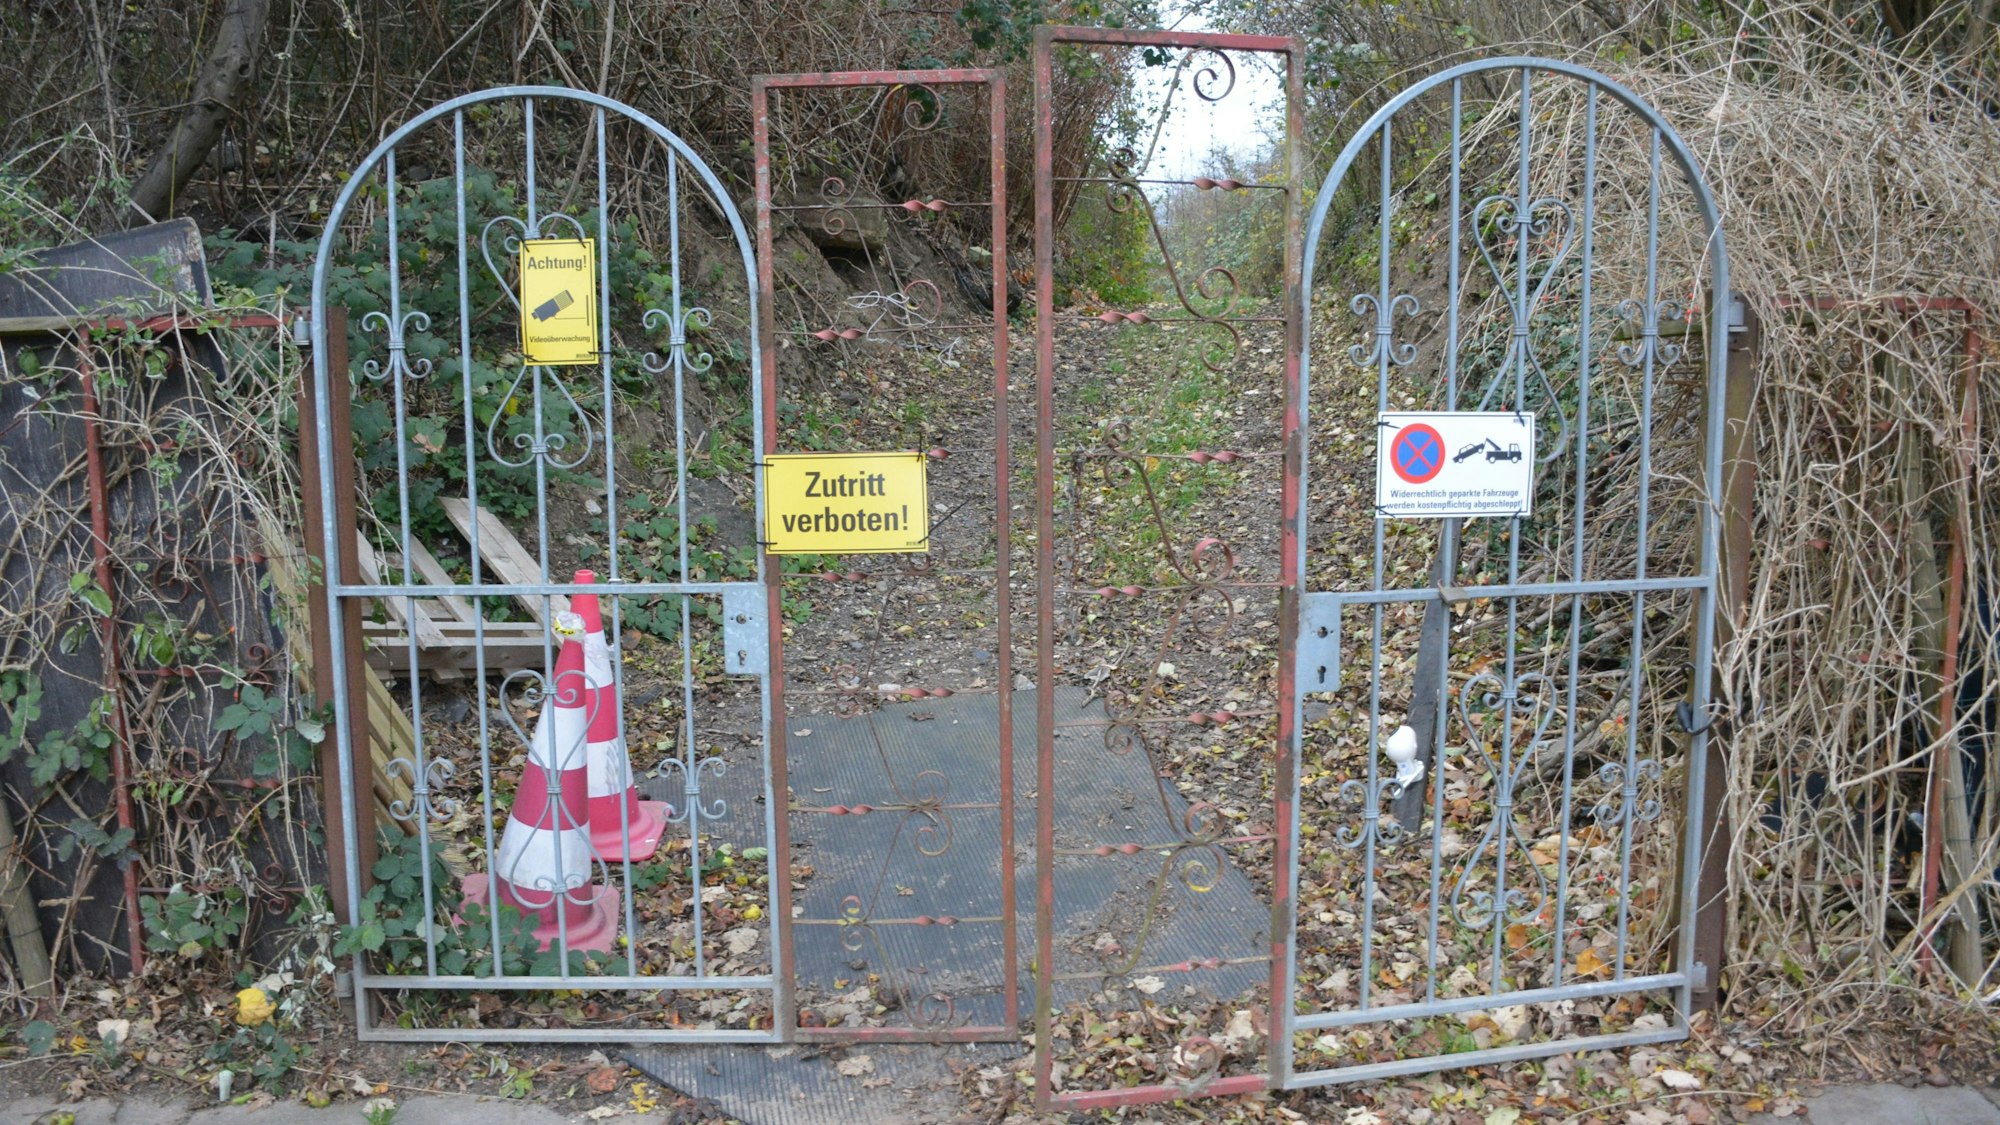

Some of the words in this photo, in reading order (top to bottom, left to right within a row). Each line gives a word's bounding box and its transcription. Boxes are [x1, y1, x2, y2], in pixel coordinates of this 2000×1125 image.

[527, 255, 587, 271] Achtung!
[529, 335, 591, 343] Videoüberwachung
[805, 471, 886, 498] Zutritt
[1390, 489, 1447, 498] Widerrechtlich
[1448, 490, 1481, 499] geparkte
[1482, 488, 1519, 498] Fahrzeuge
[1386, 501, 1416, 509] werden
[1417, 500, 1472, 510] kostenpflichtig
[1473, 500, 1522, 509] abgeschleppt!
[782, 505, 908, 533] verboten!
